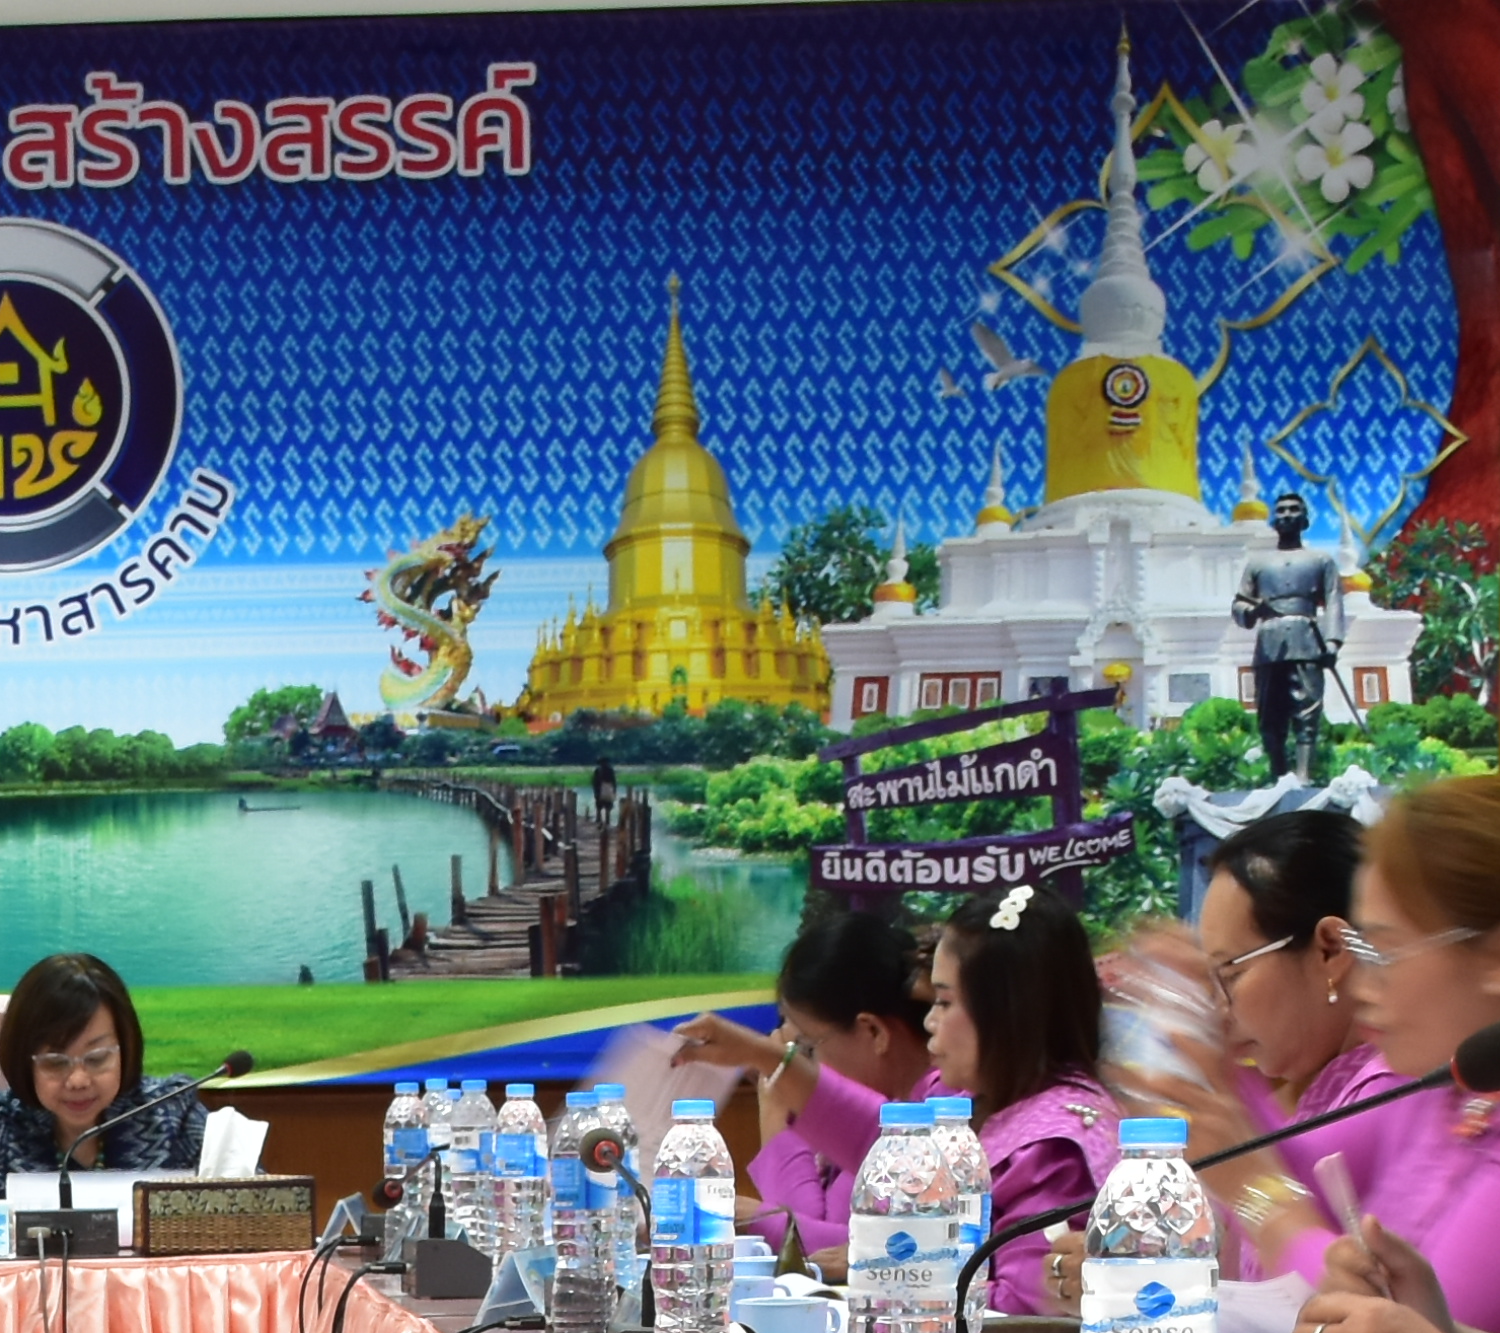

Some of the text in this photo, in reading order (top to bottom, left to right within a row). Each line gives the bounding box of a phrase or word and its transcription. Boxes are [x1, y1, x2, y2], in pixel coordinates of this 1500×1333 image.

[2, 62, 537, 190] สร้างสรรค์
[847, 748, 1057, 808] สะพานไม้แกดำ
[821, 829, 1132, 885] ยินดีต้อนรับ WELCOME
[865, 1265, 934, 1283] Sense
